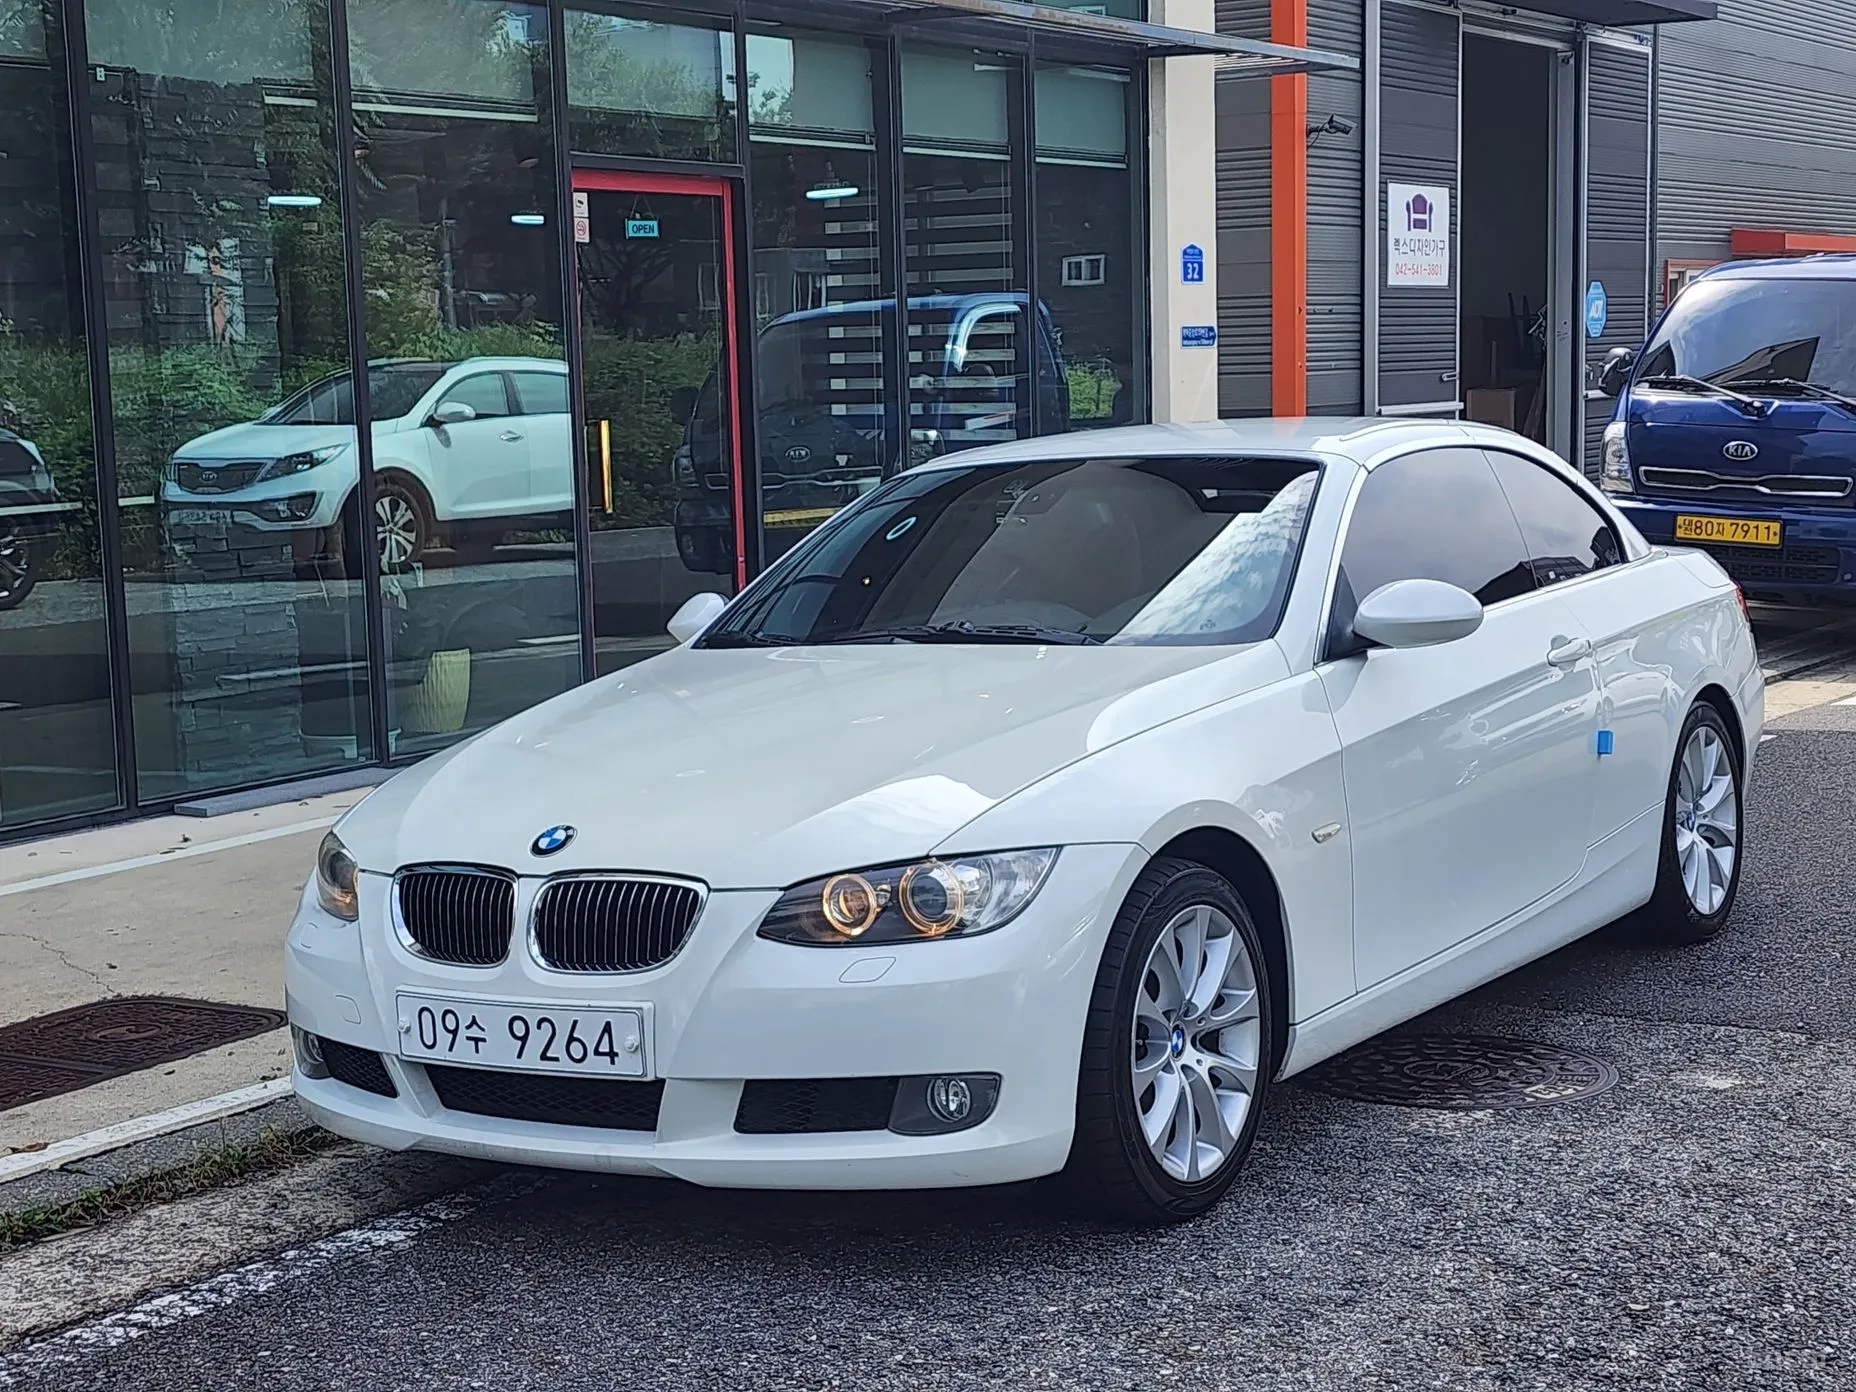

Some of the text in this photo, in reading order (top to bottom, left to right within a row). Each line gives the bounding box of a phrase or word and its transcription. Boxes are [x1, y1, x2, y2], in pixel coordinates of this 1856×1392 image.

[632, 224, 655, 234] OPEN
[1187, 263, 1199, 279] 32
[1728, 445, 1752, 457] KIA
[1729, 522, 1772, 541] 7911
[417, 1006, 619, 1066] 09수 9264
